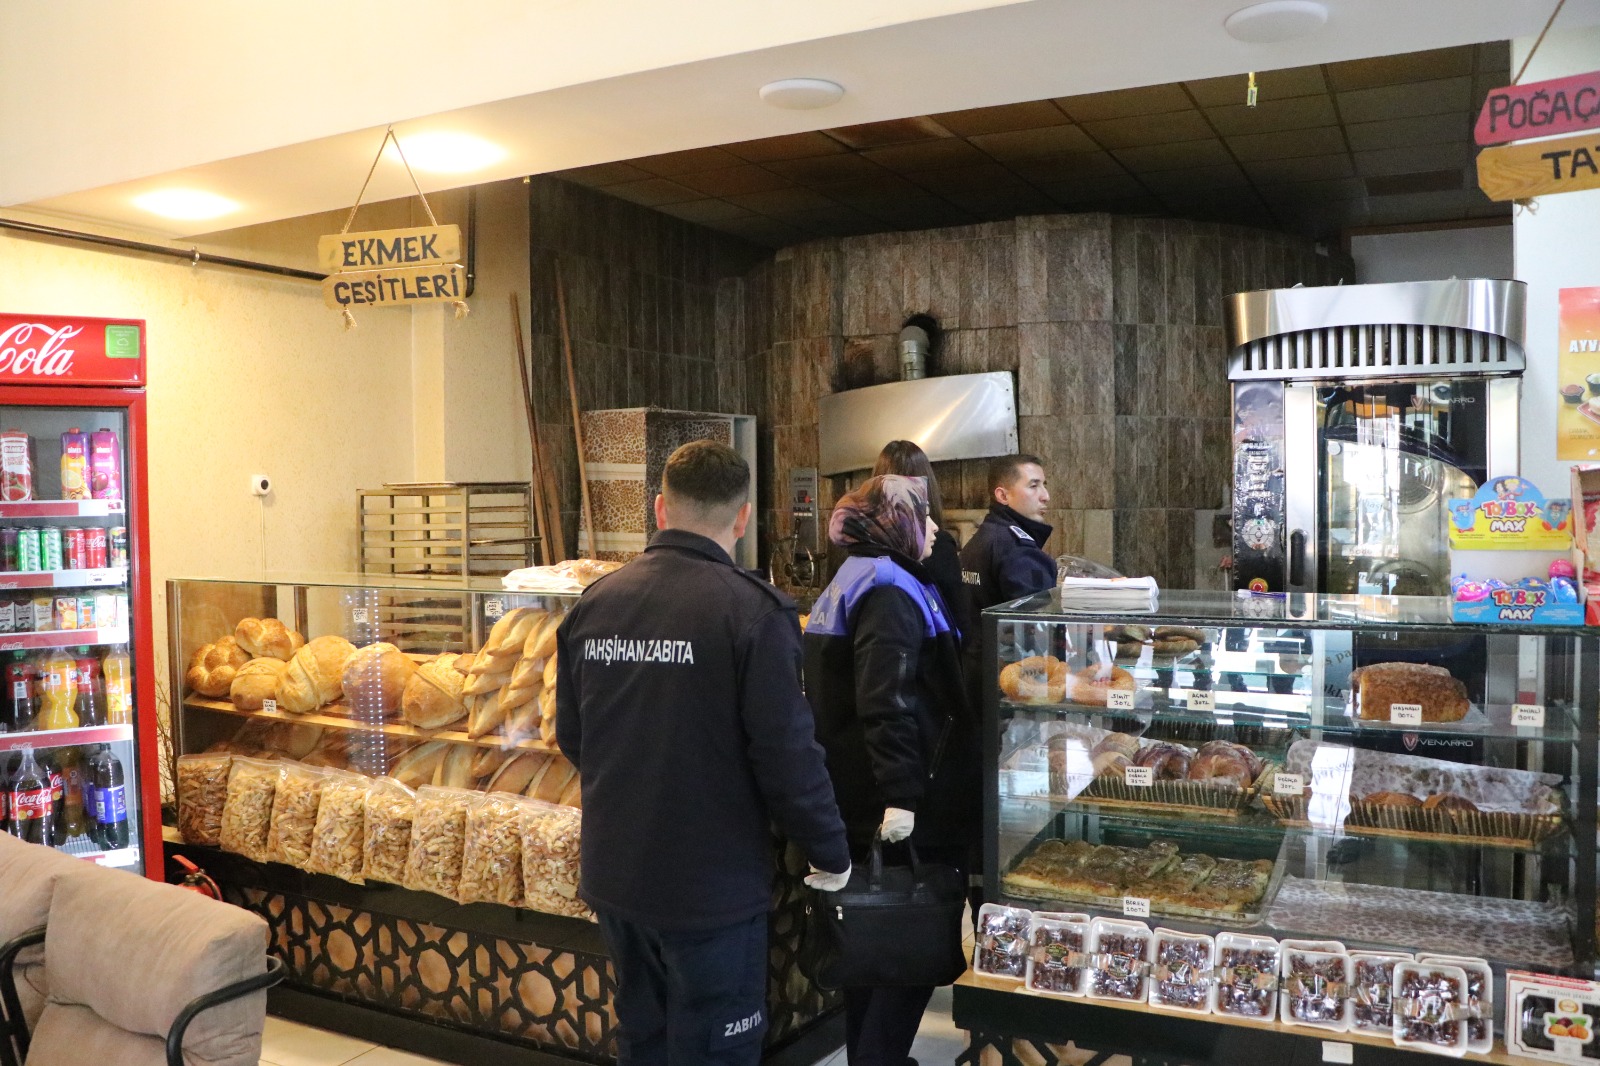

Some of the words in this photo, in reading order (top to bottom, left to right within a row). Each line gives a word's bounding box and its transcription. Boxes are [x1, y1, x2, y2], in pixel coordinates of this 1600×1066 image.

[1490, 88, 1600, 133] POĞAÇ
[1541, 146, 1600, 180] TA
[342, 234, 441, 266] EKMEK
[334, 267, 459, 307] ÇEŞİTLERİ
[1569, 340, 1600, 353] AYV
[1490, 519, 1526, 533] MAX
[1499, 608, 1534, 621] MAX
[1420, 738, 1474, 747] VENARRO
